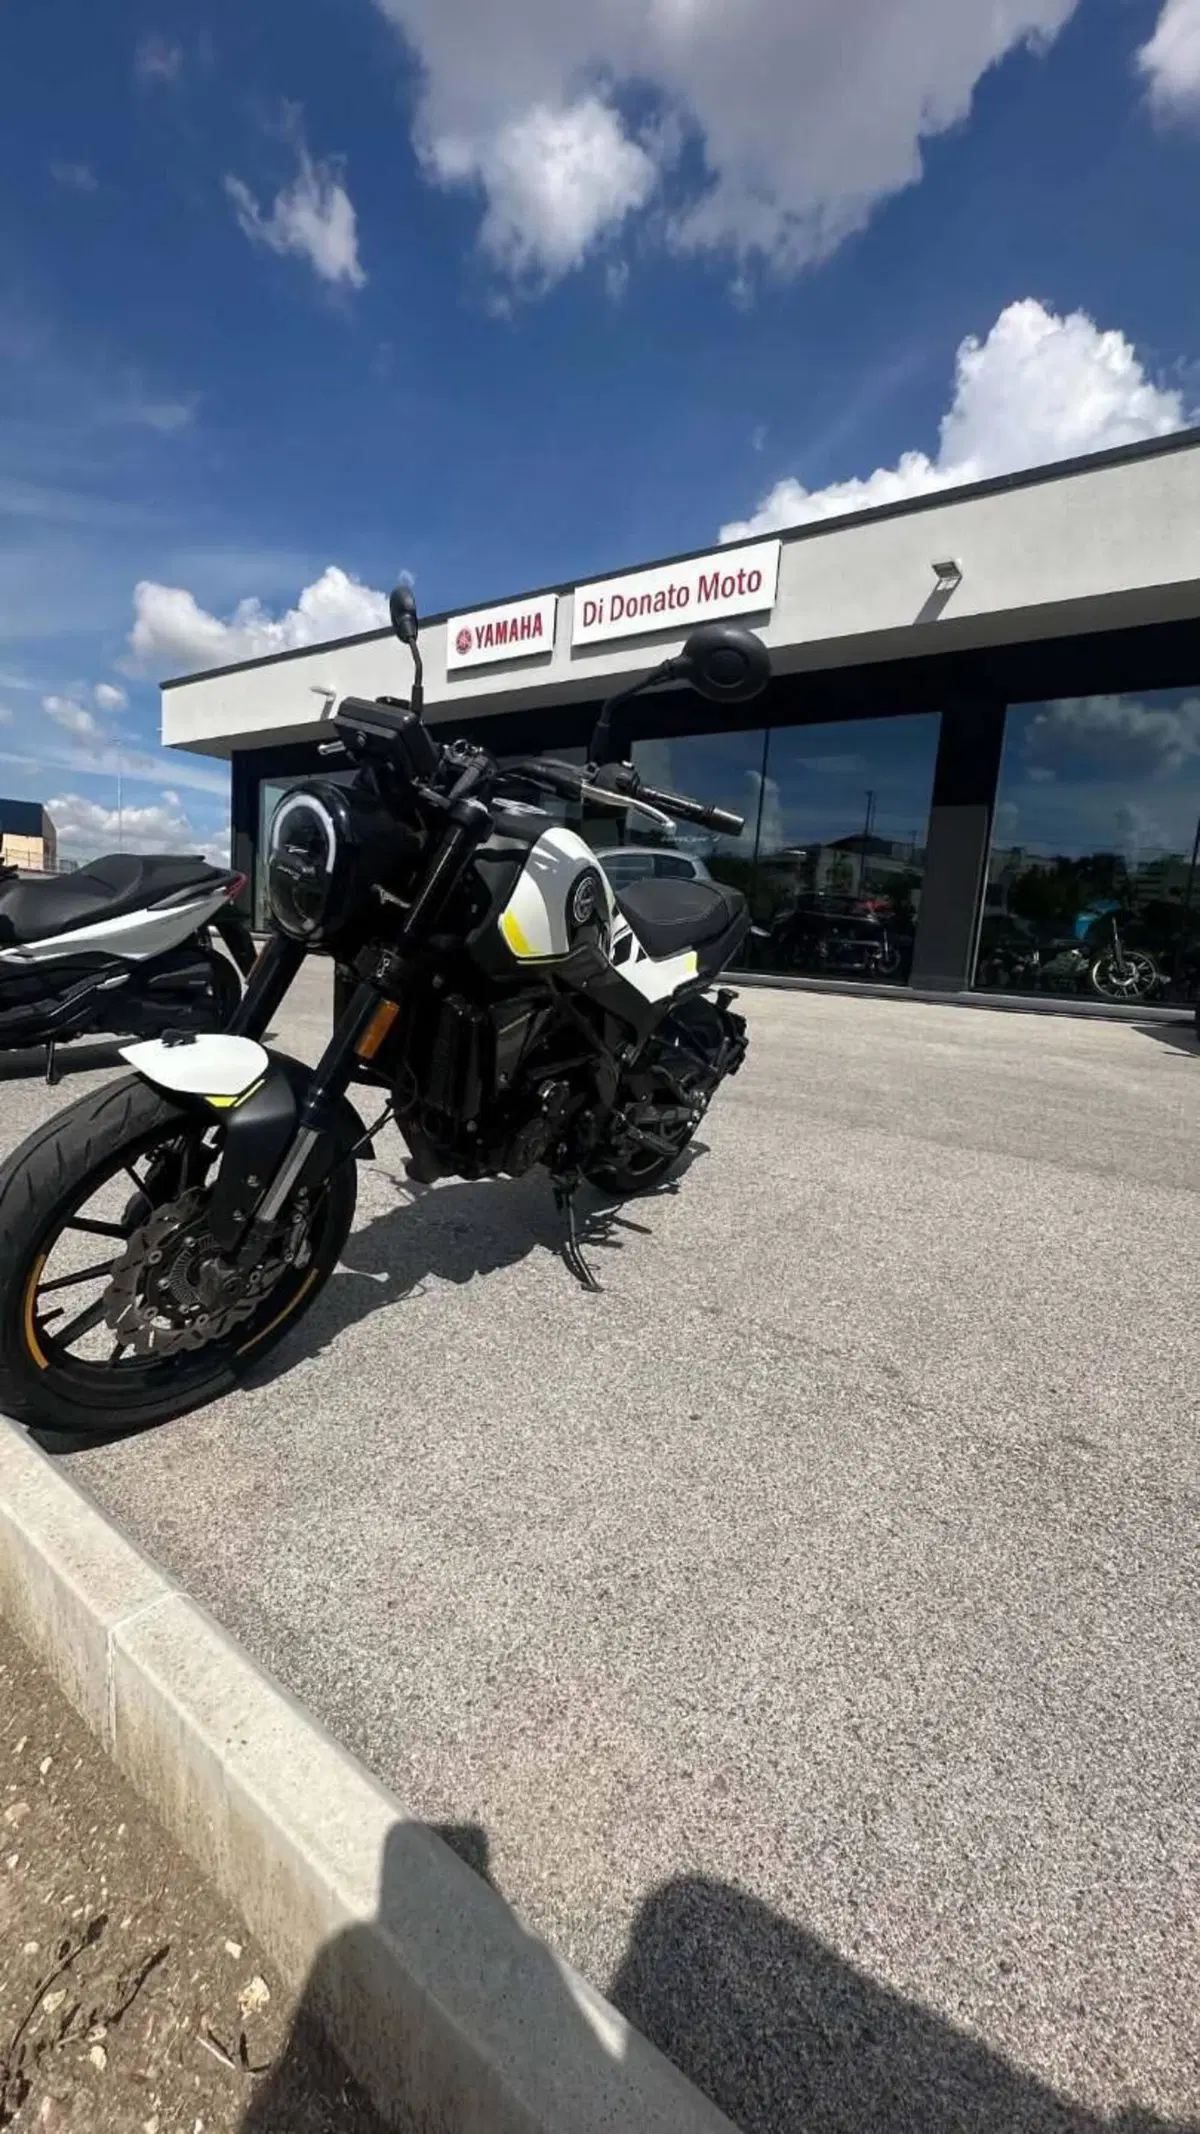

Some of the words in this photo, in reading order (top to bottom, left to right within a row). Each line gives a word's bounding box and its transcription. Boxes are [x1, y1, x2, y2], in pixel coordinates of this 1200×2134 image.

[583, 596, 603, 627] Di
[610, 582, 690, 621] Donato
[697, 569, 762, 604] Moto
[475, 612, 543, 649] YAMAHA
